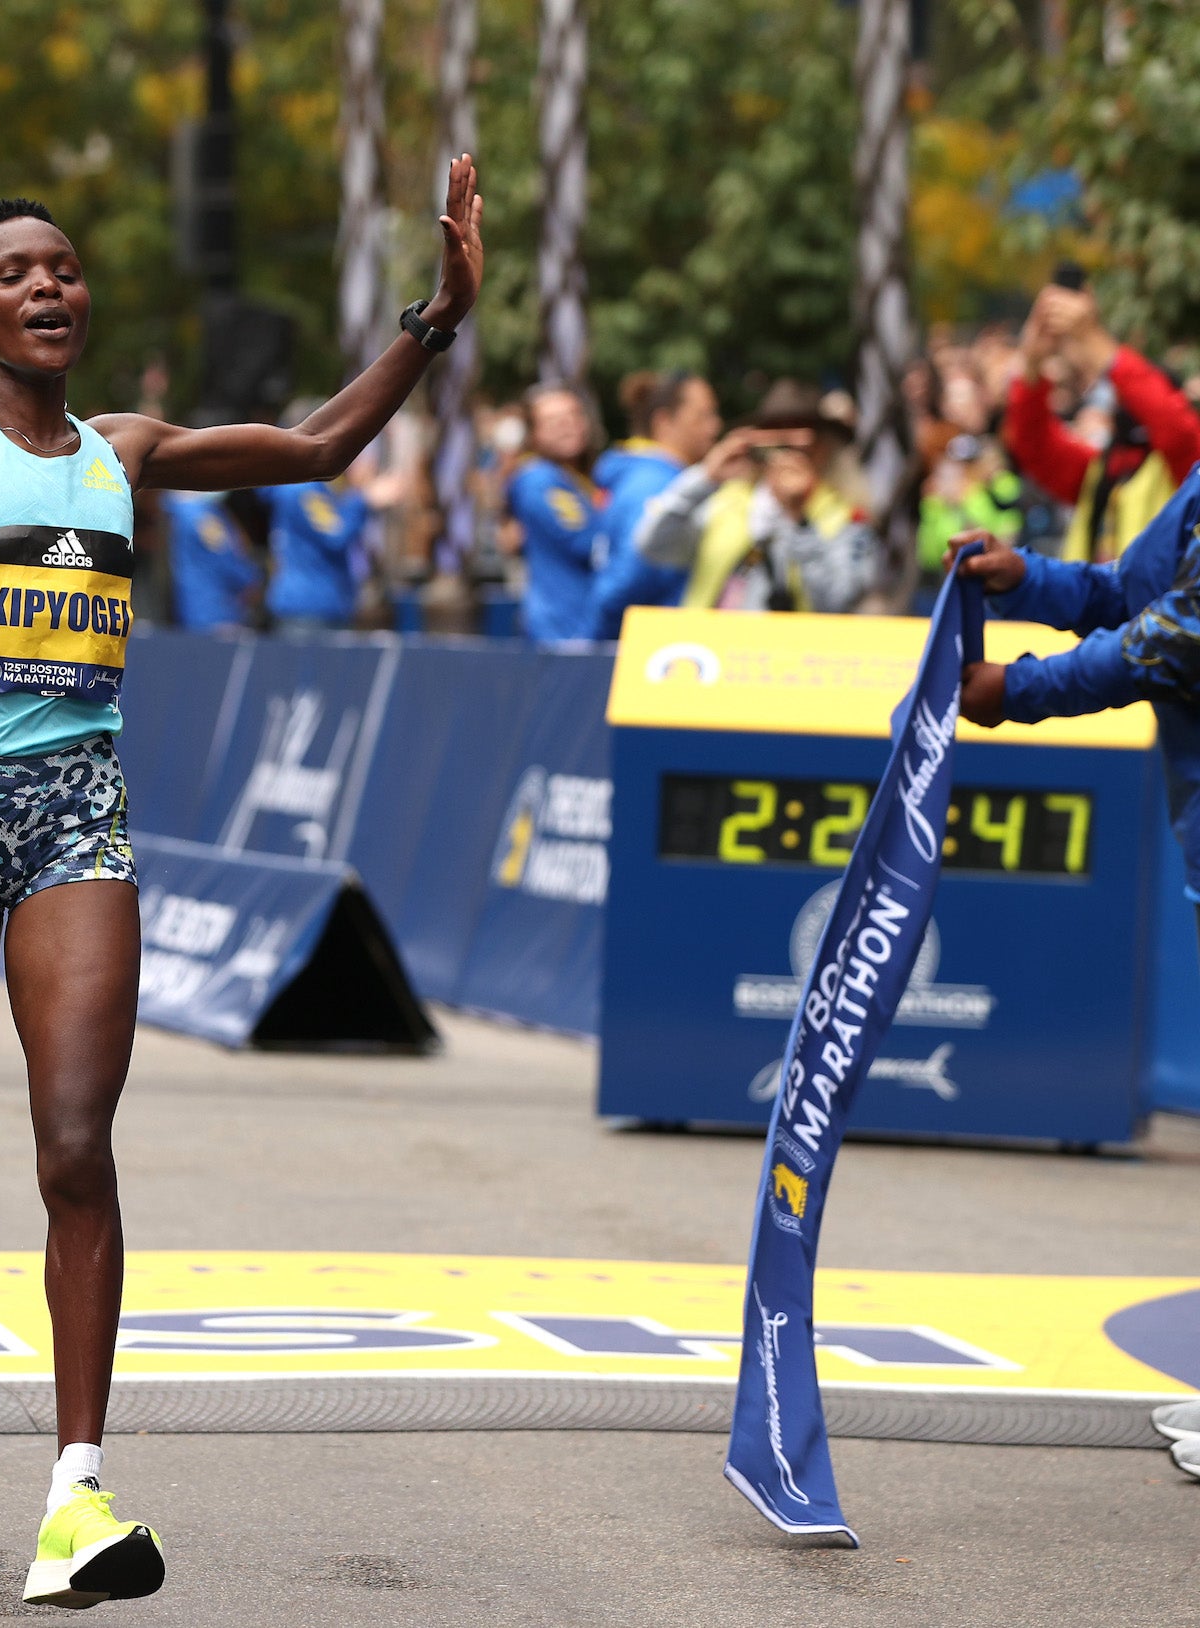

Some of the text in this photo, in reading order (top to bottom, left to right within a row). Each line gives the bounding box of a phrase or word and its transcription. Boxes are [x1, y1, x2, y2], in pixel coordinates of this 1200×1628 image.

[82, 477, 123, 493] adidas
[41, 552, 94, 568] adidas
[3, 661, 29, 672] 125TH
[29, 663, 76, 677] BOSTON
[717, 780, 1092, 873] 2:2:47
